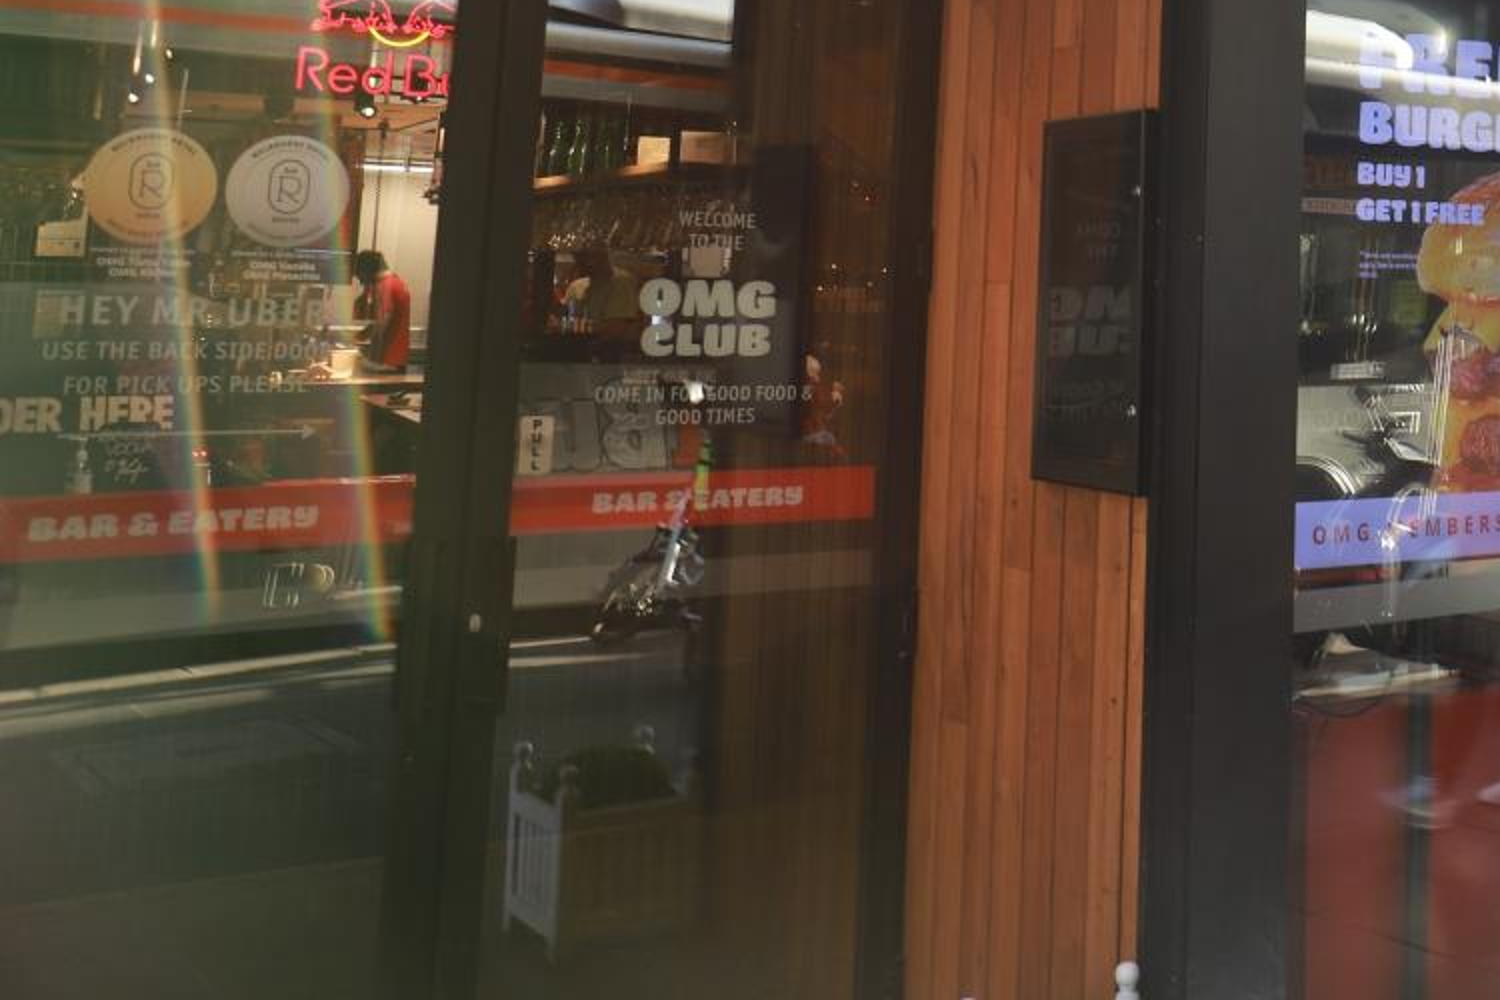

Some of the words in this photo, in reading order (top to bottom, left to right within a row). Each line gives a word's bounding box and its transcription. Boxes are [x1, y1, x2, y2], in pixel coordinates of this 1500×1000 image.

[294, 44, 394, 96] Red
[1357, 161, 1411, 188] BUY
[679, 211, 757, 229] WELCOME
[1356, 197, 1406, 222] GET
[1425, 201, 1485, 226] FREE
[64, 295, 139, 326] HEY
[228, 295, 325, 328] UBER
[639, 277, 777, 319] OMG
[42, 339, 88, 361] USE
[97, 340, 142, 361] THE
[215, 340, 267, 361] SIDE
[640, 321, 772, 357] CLUB
[64, 375, 107, 394] FOR
[117, 375, 170, 394] PICK
[595, 385, 641, 402] COME
[646, 385, 665, 401] IN
[756, 384, 797, 400] FOOD
[656, 409, 701, 425] GOOD
[706, 408, 755, 425] TIMES
[532, 419, 542, 472] PULL
[591, 491, 657, 514] BAR
[693, 486, 804, 512] EATERY
[28, 514, 119, 542] BAR
[128, 511, 160, 538] &
[168, 504, 321, 535] EATERY
[1312, 522, 1369, 546] OMG
